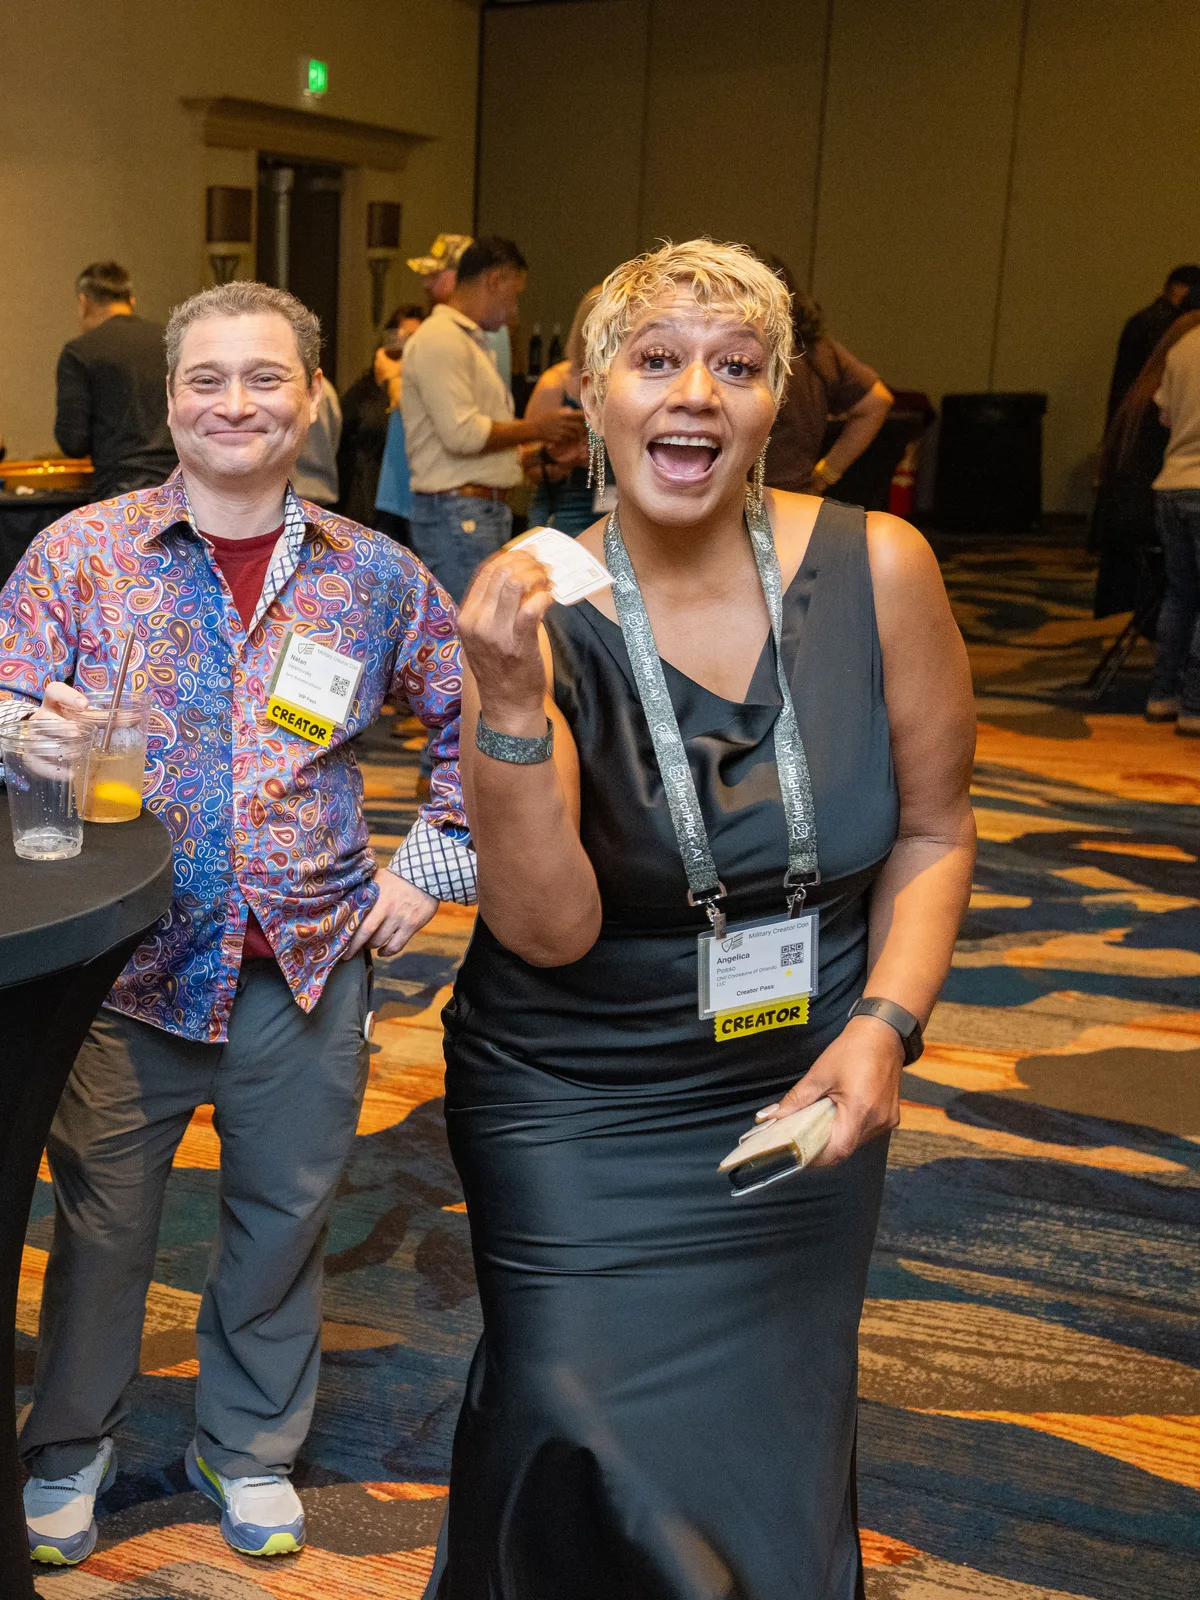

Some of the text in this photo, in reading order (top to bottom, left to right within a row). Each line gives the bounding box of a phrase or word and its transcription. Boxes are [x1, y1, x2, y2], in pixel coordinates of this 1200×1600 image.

[290, 654, 307, 666] Natan
[634, 627, 660, 702] MerchPilot AI
[273, 705, 327, 740] CREATOR
[783, 740, 804, 823] MerchPilot AI
[676, 782, 704, 862] MerchPilot AI
[749, 930, 772, 939] Military
[773, 925, 796, 934] Creator
[716, 952, 751, 965] Angelica
[716, 965, 737, 974] Posso
[736, 983, 775, 996] Creator Pass
[721, 1005, 801, 1034] CREATOR
